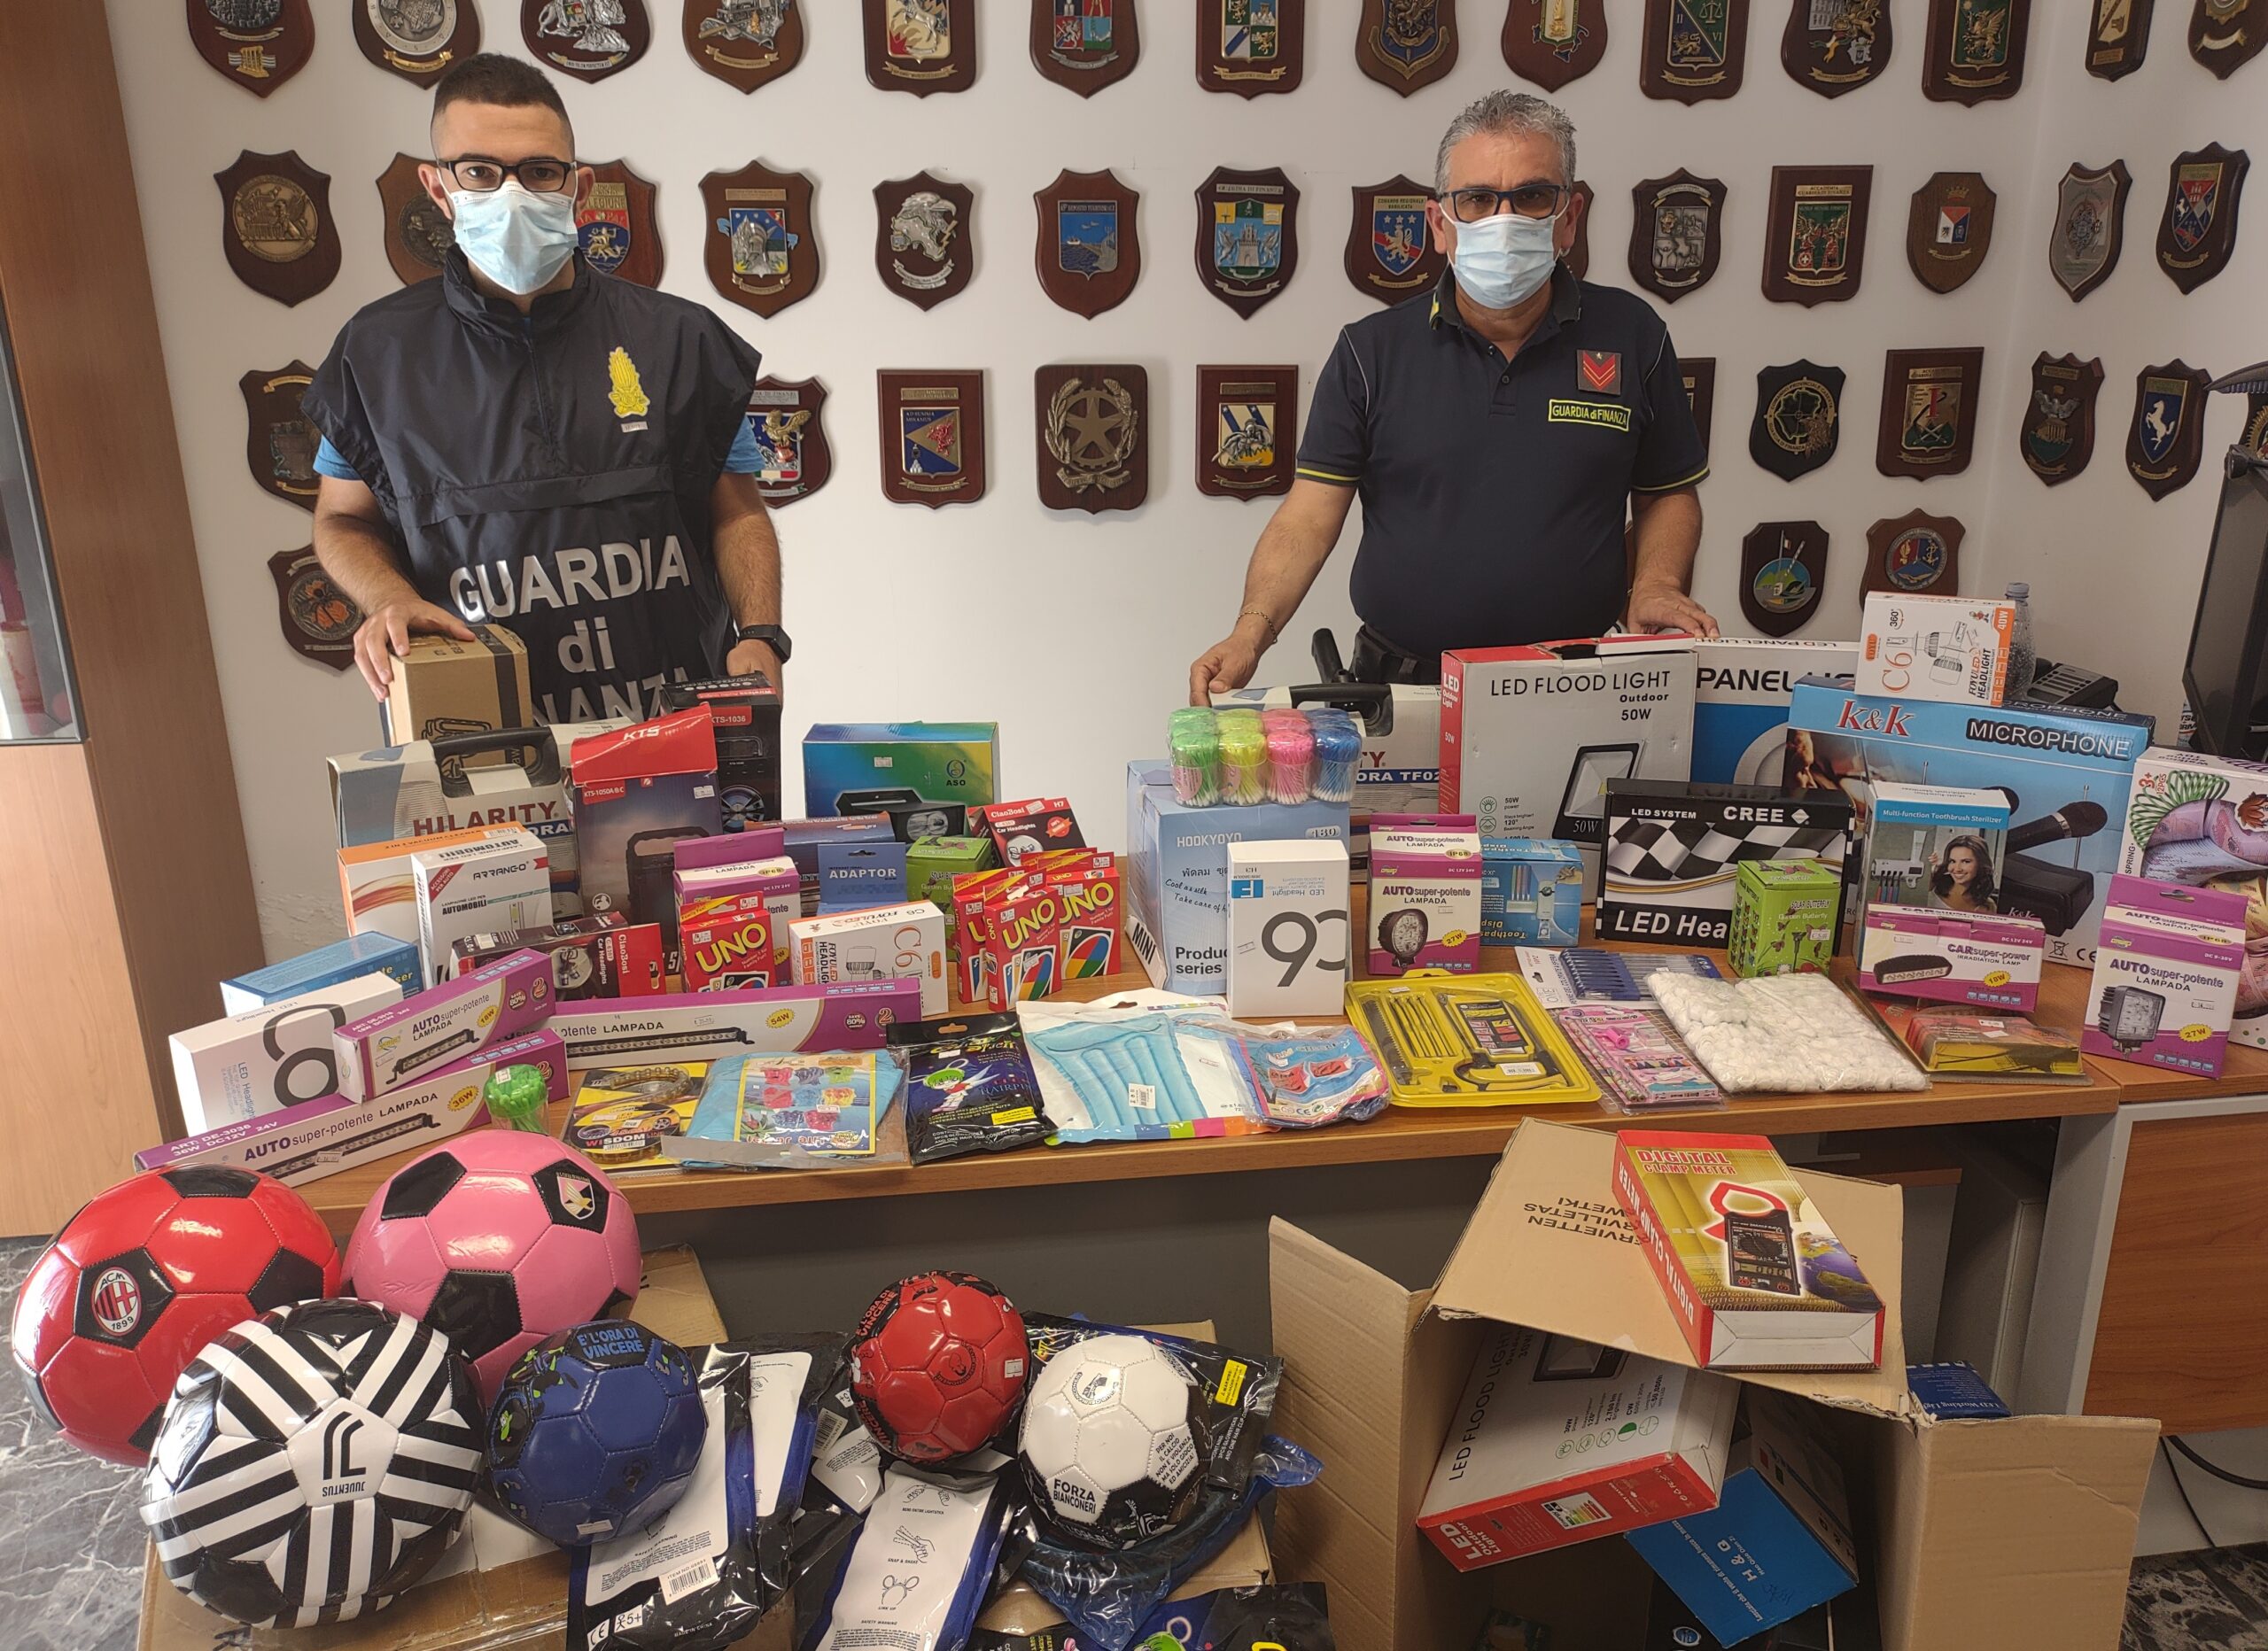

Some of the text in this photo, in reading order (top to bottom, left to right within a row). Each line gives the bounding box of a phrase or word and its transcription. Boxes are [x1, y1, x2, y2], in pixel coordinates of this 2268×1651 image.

[1552, 405, 1627, 425] GUARDIA di FINANZA
[449, 535, 690, 622] GUARDIA
[1996, 610, 2009, 630] 40W
[557, 616, 617, 673] di
[1697, 669, 1790, 692] PANEL
[1880, 651, 1913, 694] C6
[1969, 655, 1981, 696] FOYULED
[1977, 648, 1992, 699] HEADLIGHT
[1443, 672, 1459, 693] LED
[1491, 670, 1671, 696] LED FLOOD LIGHT
[1442, 689, 1458, 702] Outdoor
[1442, 698, 1453, 709] Light
[1619, 692, 1669, 702] Outdoor
[1621, 709, 1651, 721] 50W
[1837, 700, 1915, 737] K&K
[624, 725, 661, 742] KTS
[1444, 732, 1455, 744] 50W
[1969, 721, 2131, 759] MICROPHONE
[2139, 772, 2155, 788] 3+
[1053, 800, 1065, 809] H7
[413, 801, 557, 837] HILARITY
[1631, 808, 1697, 819] LED SYSTEM
[1723, 806, 1784, 823] CREE
[1883, 810, 2002, 825] Multi-function Toothbrush Sterilizer
[1007, 823, 1037, 833] Headlights
[1573, 820, 1598, 833] 50W
[1177, 833, 1242, 848] HOOKYOYO
[716, 864, 757, 873] LAMPADA
[2124, 848, 2136, 874] SPRING
[431, 866, 450, 890] ACCESSORI
[829, 868, 897, 880] ADAPTOR
[1052, 872, 1072, 884] UNO
[1165, 878, 1208, 895] Cool silk
[1272, 888, 1305, 897] Headlight
[1383, 886, 1471, 899] AUTO super-potente
[443, 899, 486, 916] AUTOMOBILI
[1174, 892, 1213, 908] Take care
[1790, 899, 1830, 909] SOLAR BUTTERFLY
[986, 919, 996, 940] UNO
[1003, 898, 1055, 950] UNO
[1614, 909, 1670, 933] LED
[2125, 911, 2227, 934] AUTO super-potente
[2149, 919, 2199, 932] LAMPADA
[894, 925, 922, 968] C6
[1131, 922, 1155, 965] MINI
[1446, 933, 1463, 945] 27W
[695, 923, 766, 973] UNO
[1947, 942, 2031, 961] CAR super-power
[829, 942, 838, 982] FOYULED
[1957, 954, 2000, 964] IRRADIATION
[598, 953, 608, 985] Headlights
[1176, 962, 1222, 975] series
[2109, 957, 2225, 988] AUTO super-potente
[1988, 973, 2007, 984] 18W
[2136, 975, 2191, 992] LAMPADA
[509, 996, 526, 1007] 80%
[412, 994, 490, 1035] AUTO super-potente
[479, 1008, 496, 1025] 18W
[771, 1012, 790, 1027] 54W
[878, 1008, 893, 1025] 2
[413, 1019, 453, 1042] LAMPADA
[603, 1021, 664, 1035] LAMPADA
[2184, 1027, 2207, 1038] 27W
[237, 1062, 249, 1080] LED
[453, 1088, 477, 1109] 36W
[245, 1092, 439, 1162] AUTO super-potente LAMPADA
[206, 1120, 278, 1153] DC12V 24V
[586, 1134, 647, 1146] WISDOM
[1636, 1151, 1731, 1165] DIGITAL
[1643, 1164, 1736, 1175] CLAMP METER
[1619, 1162, 1694, 1326] METER CLAMP DIGITAL
[100, 1272, 125, 1290] ACM
[861, 1290, 898, 1337] VINCERE
[111, 1315, 135, 1331] 1899
[595, 1327, 638, 1344] L'ORA DI
[582, 1338, 645, 1359] VINCERE
[1626, 1402, 1634, 1416] CW
[1222, 1416, 1239, 1446] GLOWSTICKS
[1448, 1446, 1472, 1481] LED
[1462, 1381, 1495, 1444] FLOOD
[1564, 1418, 1573, 1434] 30W
[1155, 1442, 1167, 1454] PER
[1163, 1438, 1180, 1456] CALCIO
[1155, 1435, 1192, 1478] NON VIOLENZA
[1169, 1443, 1194, 1474] SOLO GIOCO
[322, 1481, 366, 1497] JUVENTUS
[1053, 1479, 1096, 1503] FORZA
[1052, 1490, 1097, 1515] BIANCONERI
[1439, 1523, 1483, 1561] LED
[1456, 1520, 1493, 1556] Outdoor
[1475, 1531, 1502, 1554] Light
[1742, 1569, 1758, 1582] H
[626, 1615, 642, 1625] 5+
